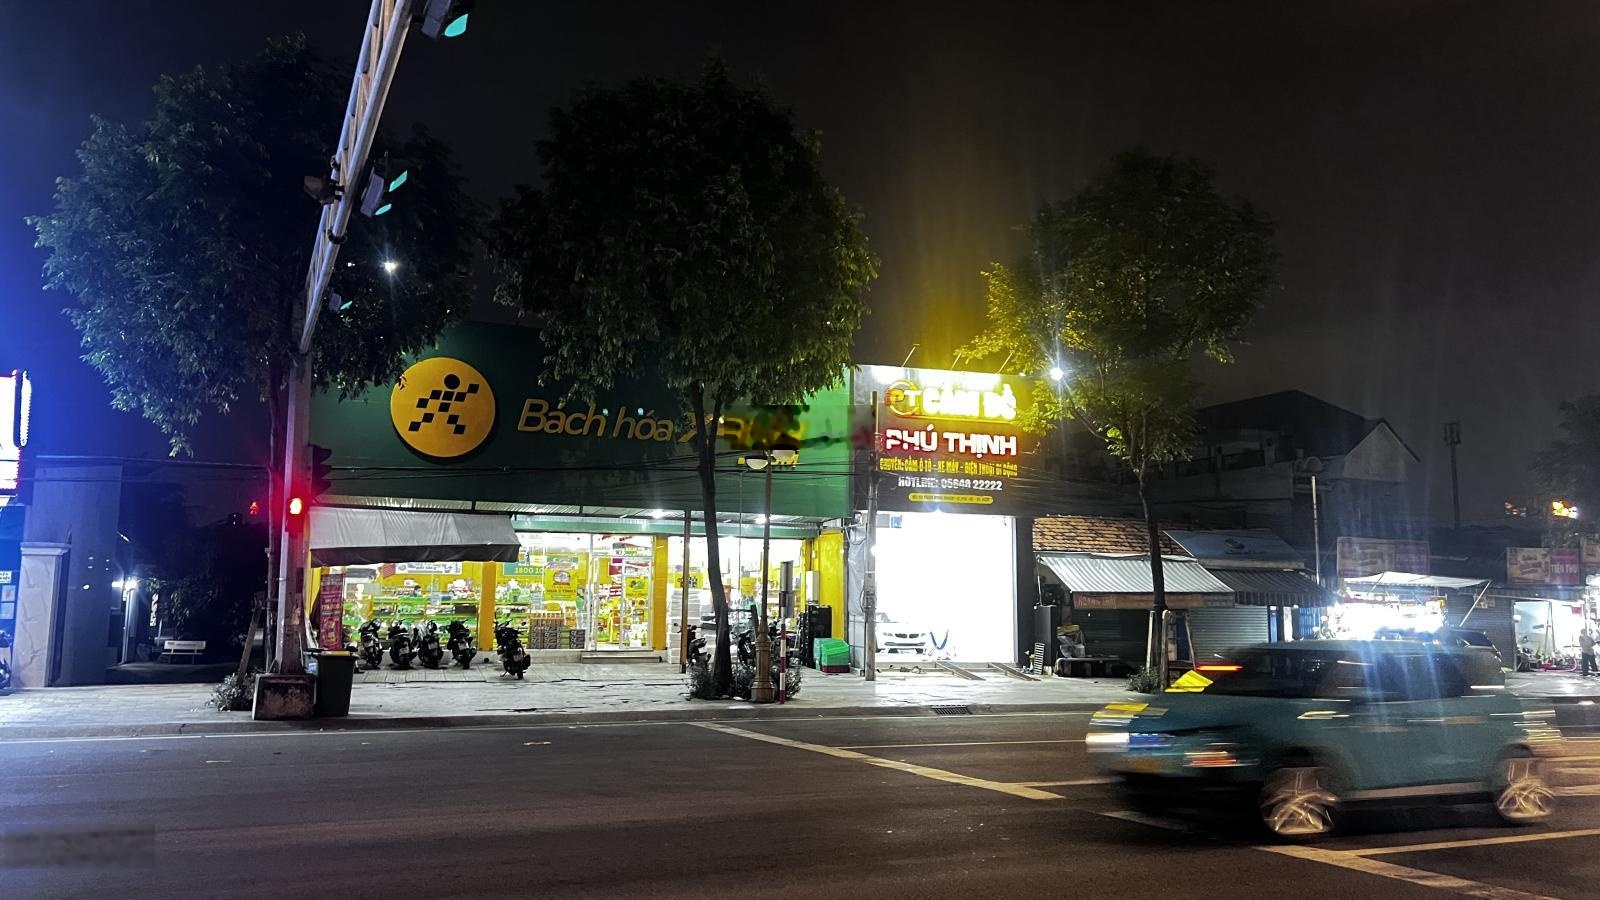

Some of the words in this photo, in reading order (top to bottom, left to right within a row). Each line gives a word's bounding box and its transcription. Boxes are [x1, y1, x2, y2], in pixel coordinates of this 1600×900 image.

[517, 398, 606, 437] Bách
[612, 406, 674, 442] hóa
[885, 423, 938, 452] PHÚ
[943, 431, 1017, 459] THỊNH
[972, 479, 1004, 491] 22222
